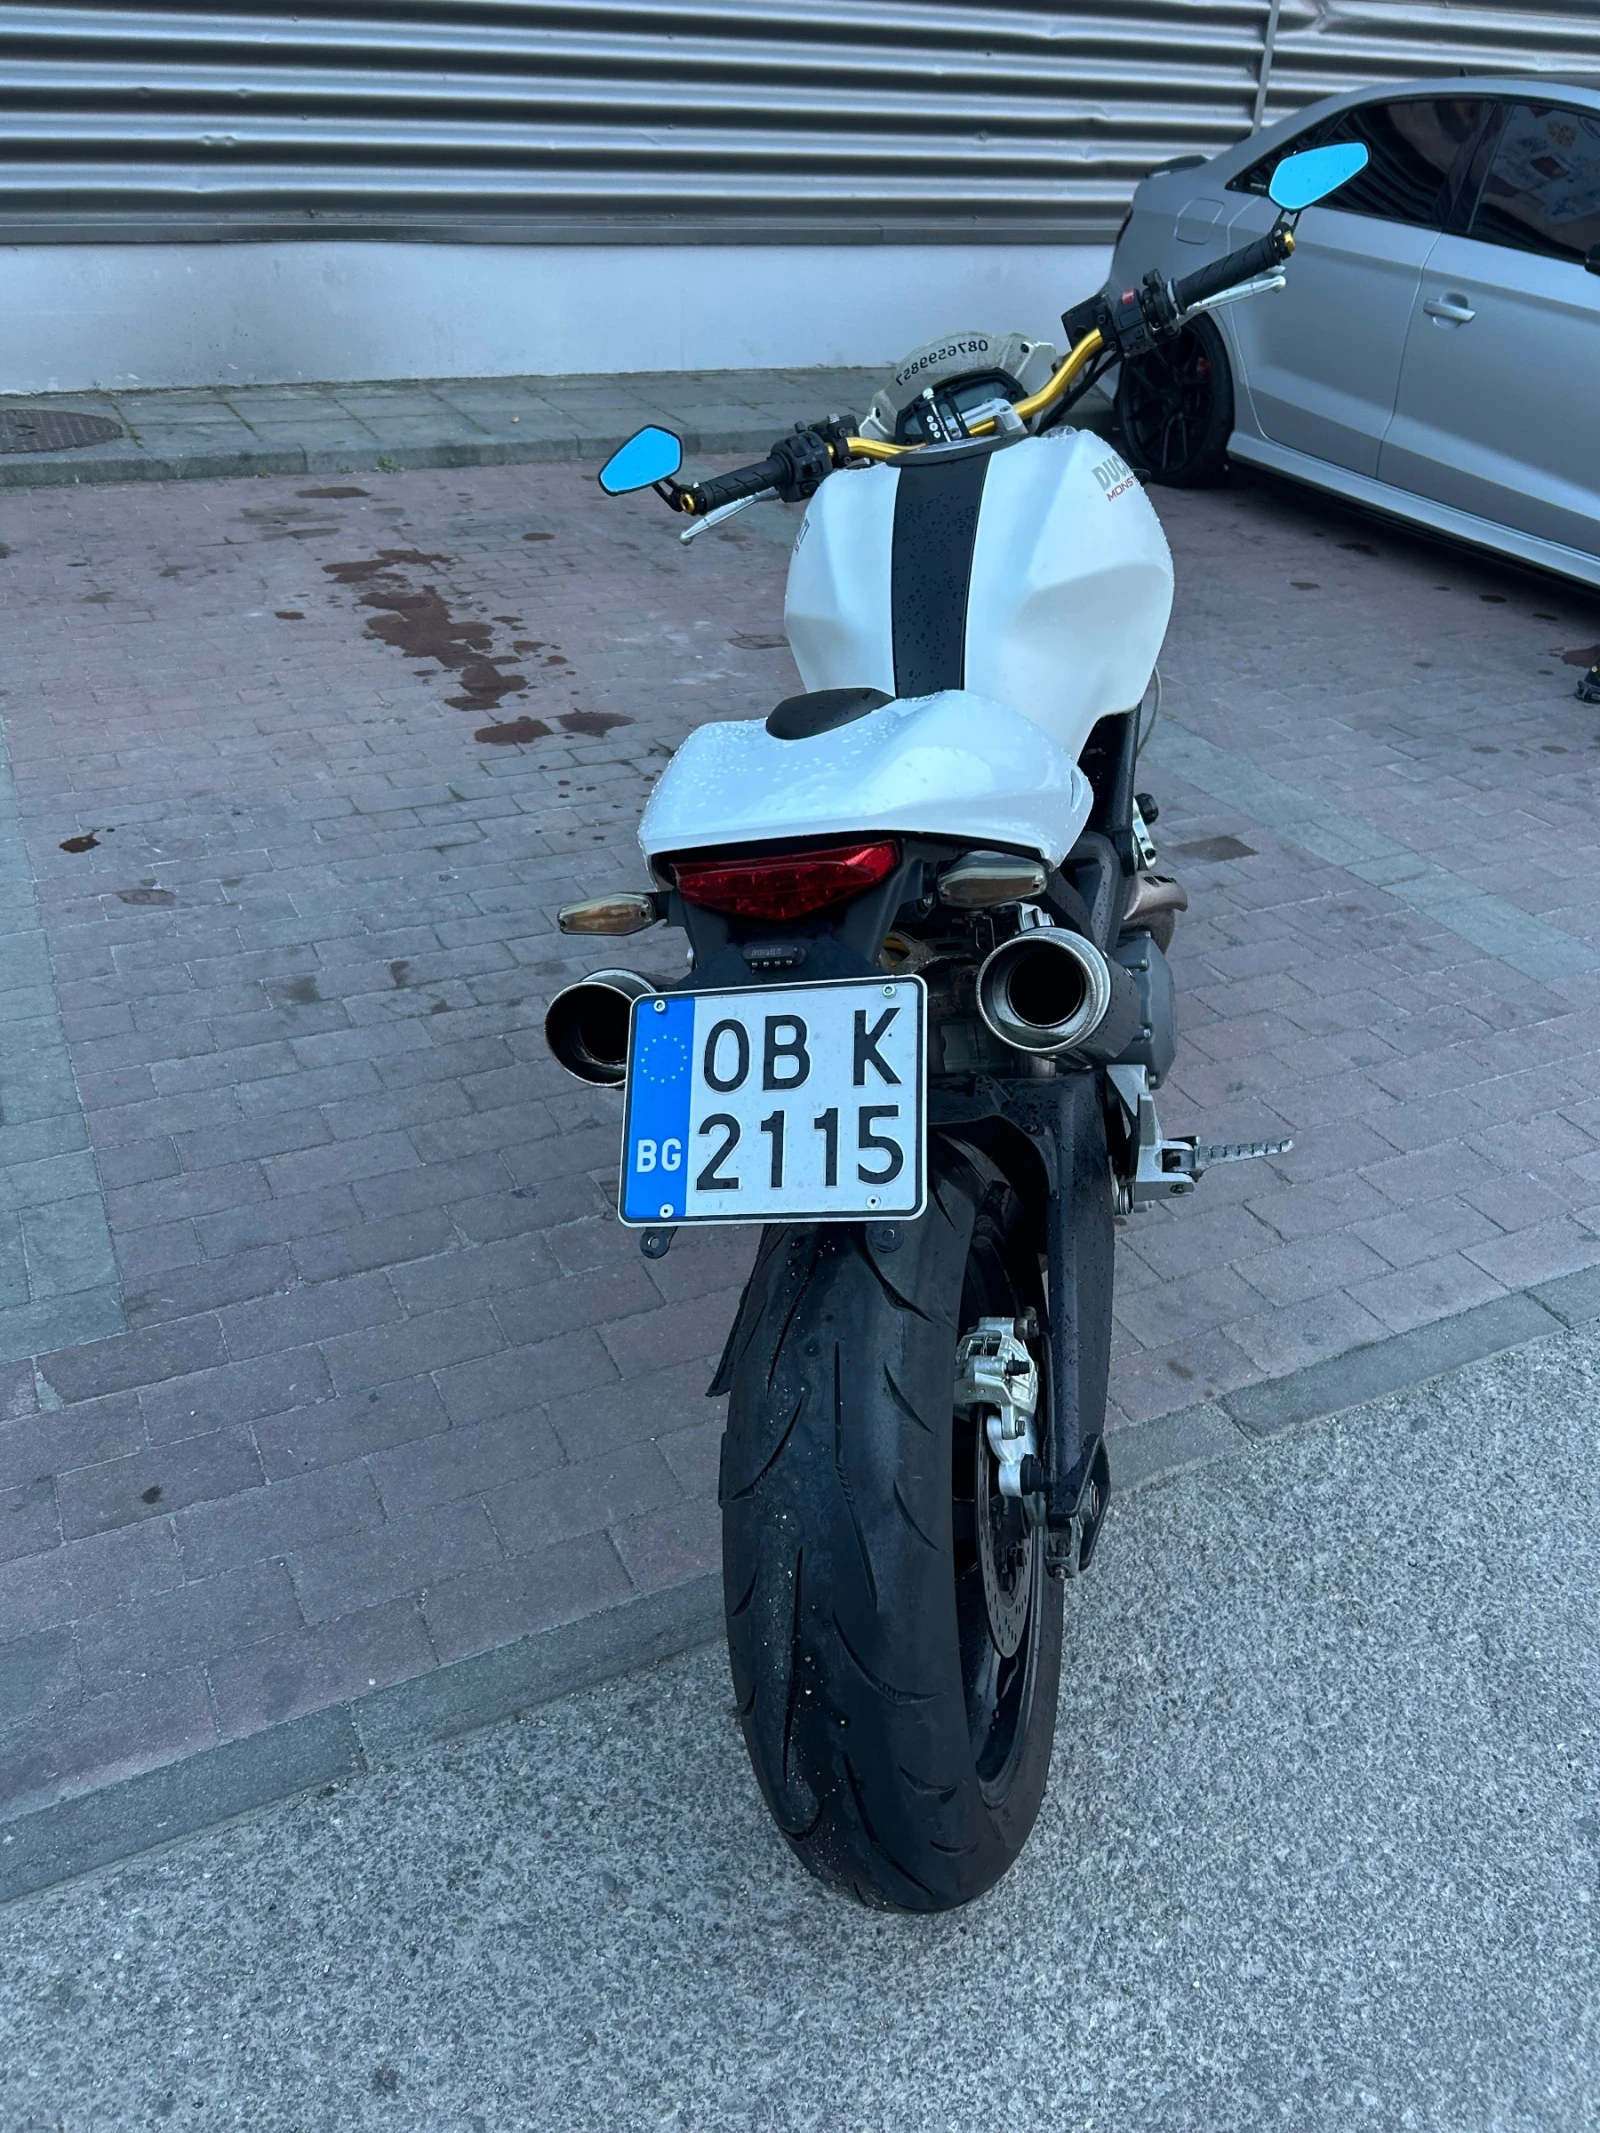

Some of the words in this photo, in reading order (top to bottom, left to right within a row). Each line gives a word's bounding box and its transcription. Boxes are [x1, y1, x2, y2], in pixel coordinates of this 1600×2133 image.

[703, 1014, 811, 1092] OB
[852, 1007, 902, 1087] K
[636, 1138, 682, 1173] BG
[695, 1104, 905, 1191] 2115
